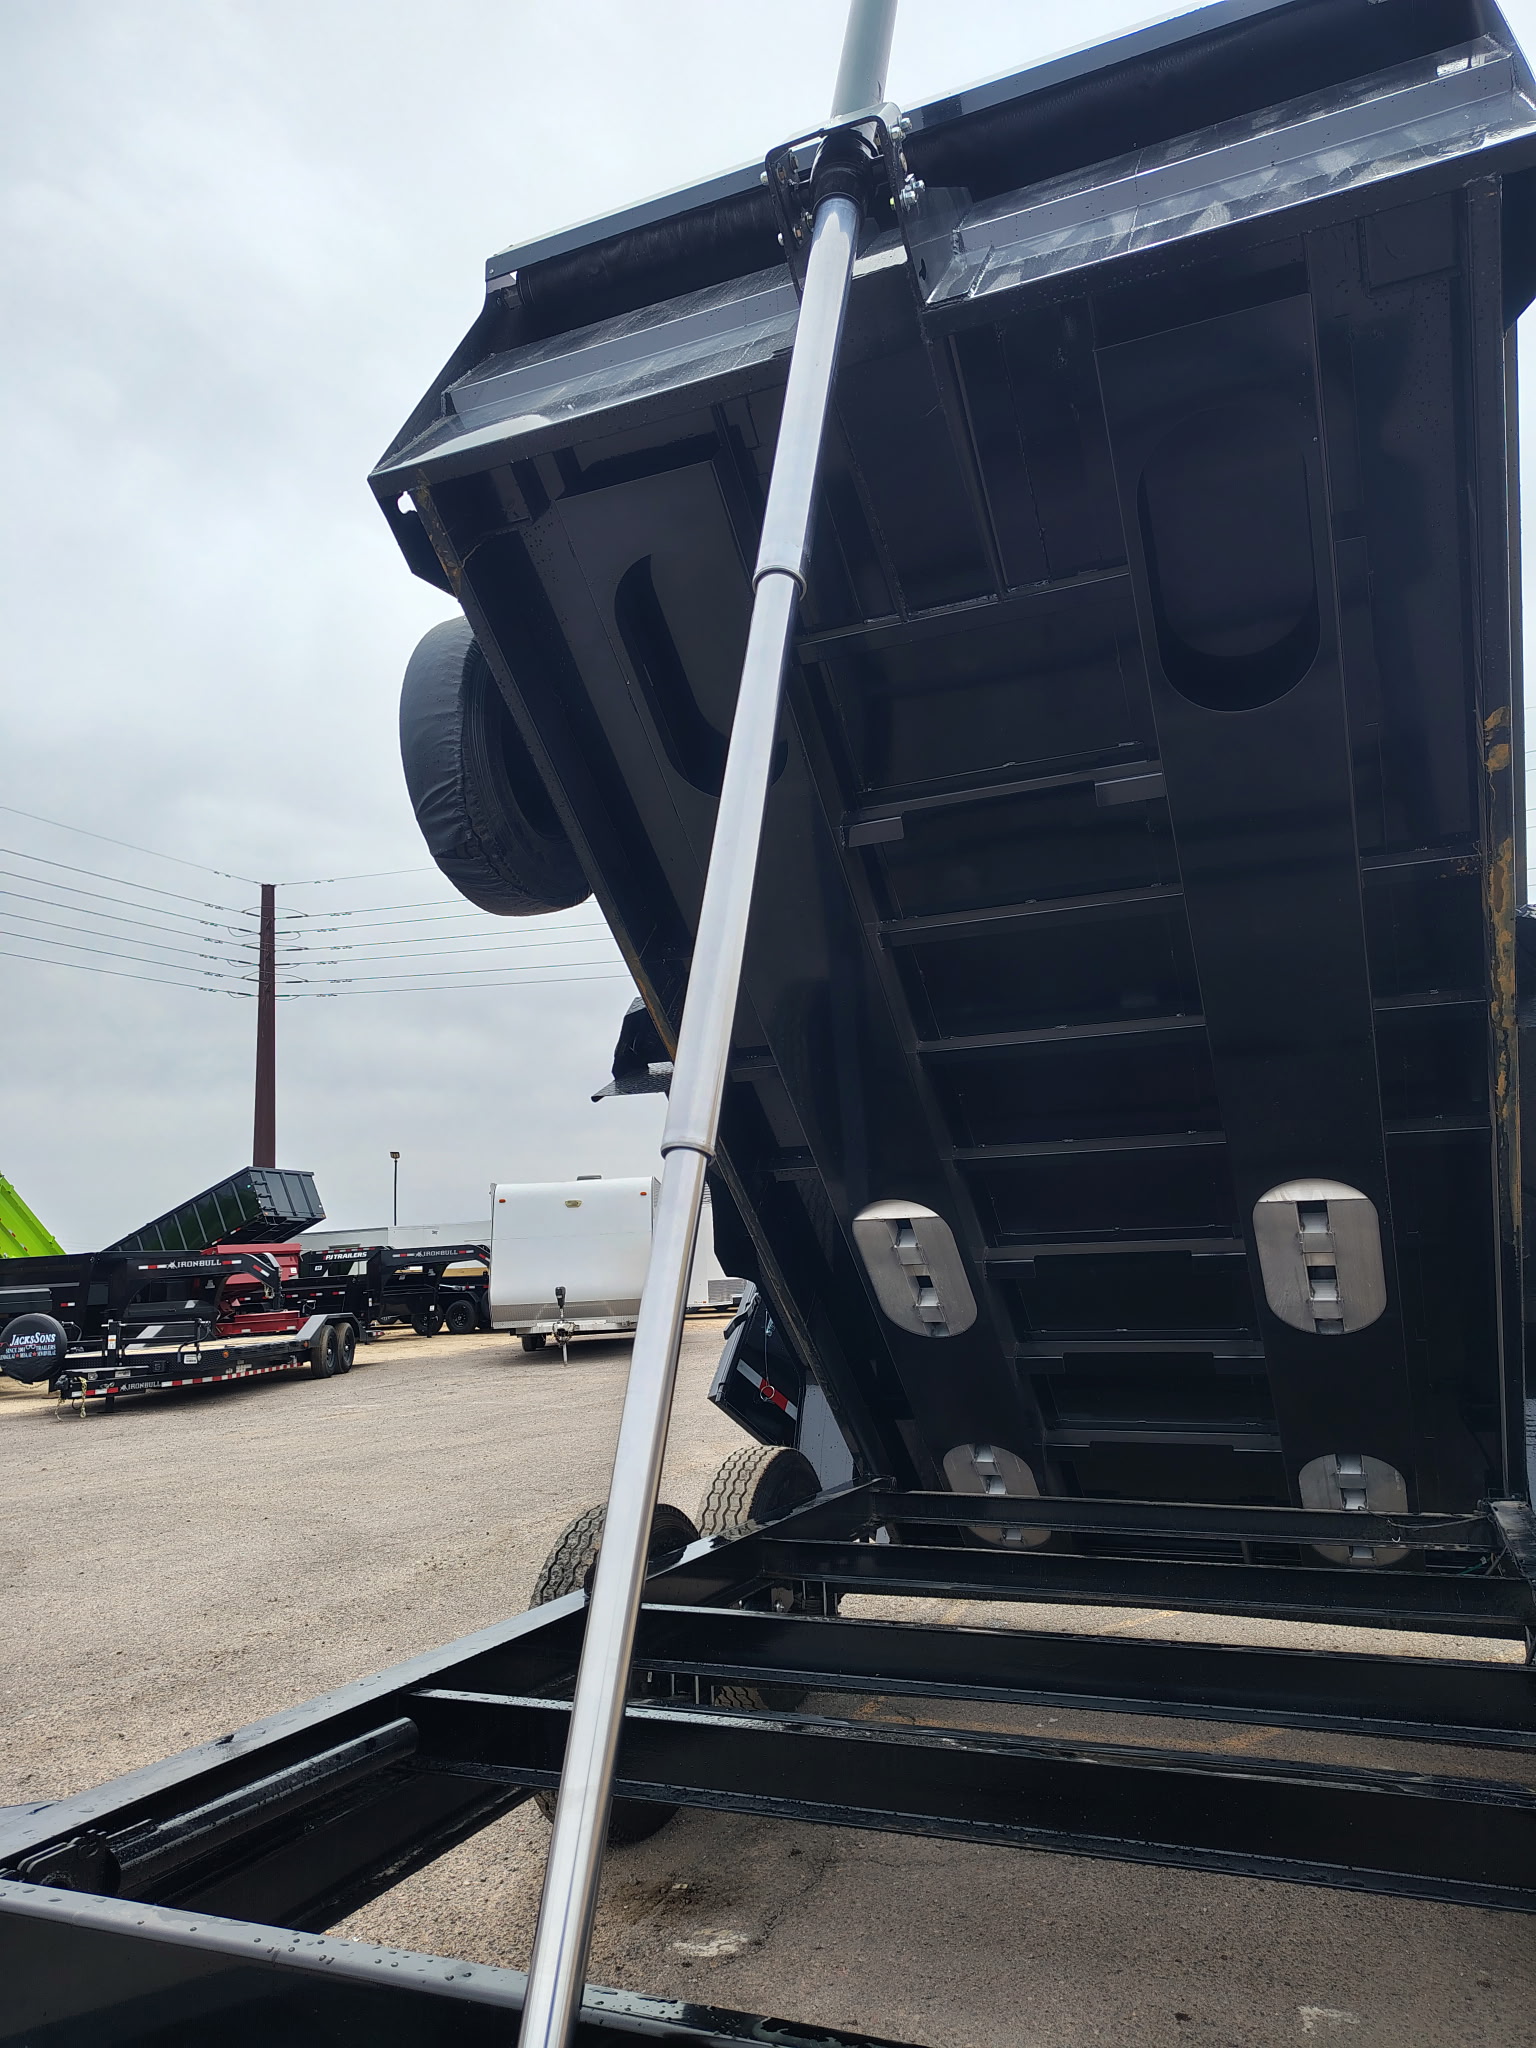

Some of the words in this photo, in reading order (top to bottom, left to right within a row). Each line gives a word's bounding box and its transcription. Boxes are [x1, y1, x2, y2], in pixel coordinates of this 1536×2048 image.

[334, 1252, 367, 1260] TRAILERS
[177, 1259, 222, 1268] IRONBULL
[128, 1381, 161, 1390] IRONBULL
